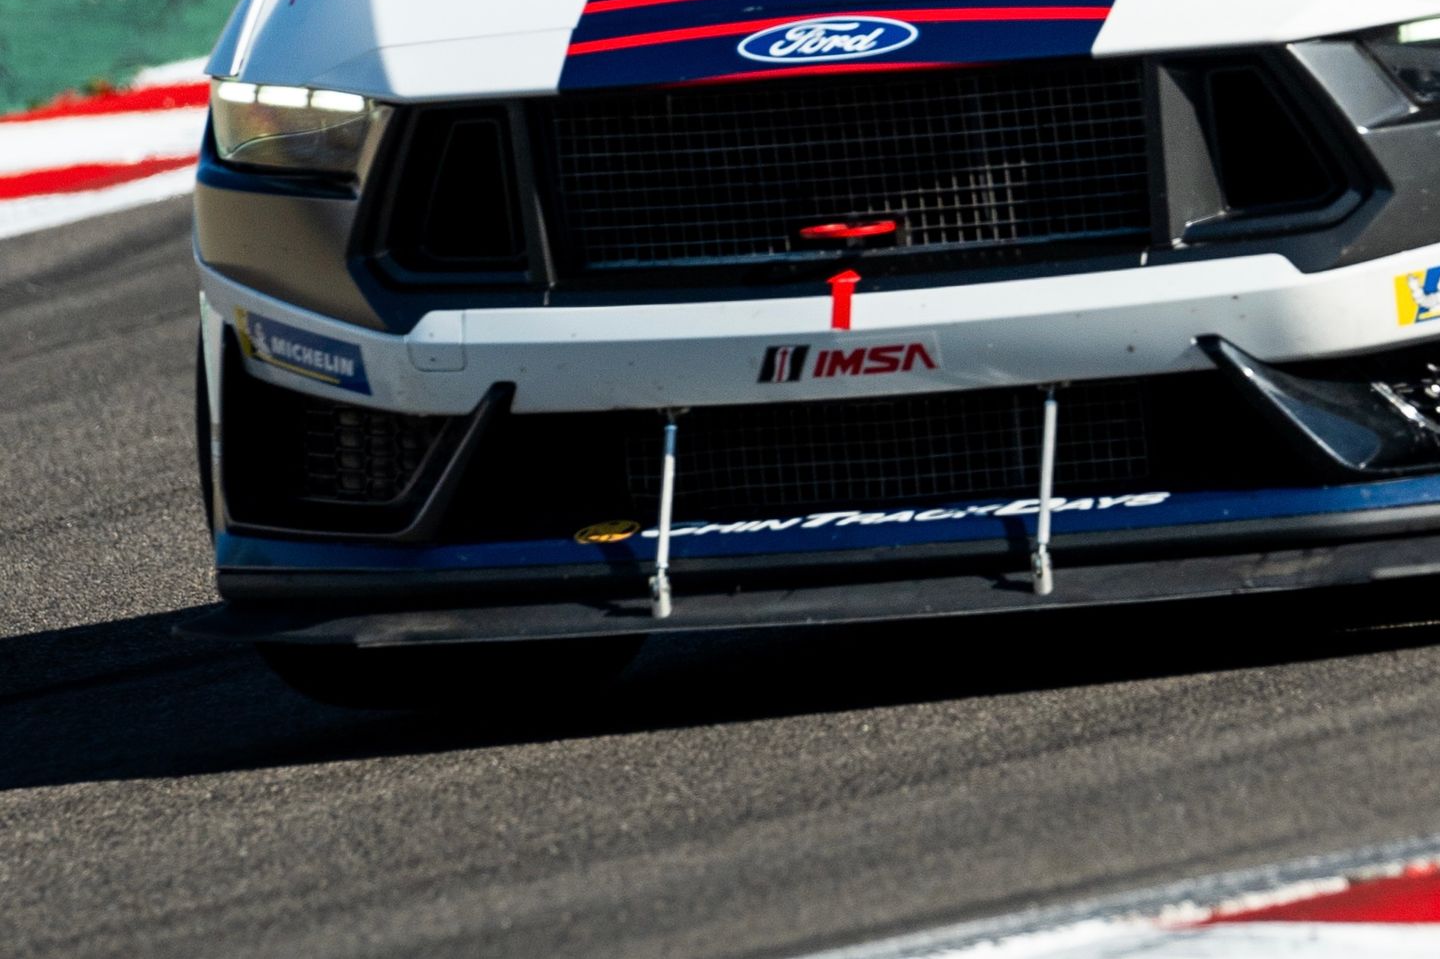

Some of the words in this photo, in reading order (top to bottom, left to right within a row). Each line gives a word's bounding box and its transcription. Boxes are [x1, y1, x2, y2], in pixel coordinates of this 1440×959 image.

[768, 22, 886, 57] Ford
[269, 336, 356, 378] MICHELIN
[812, 342, 941, 378] IMSA
